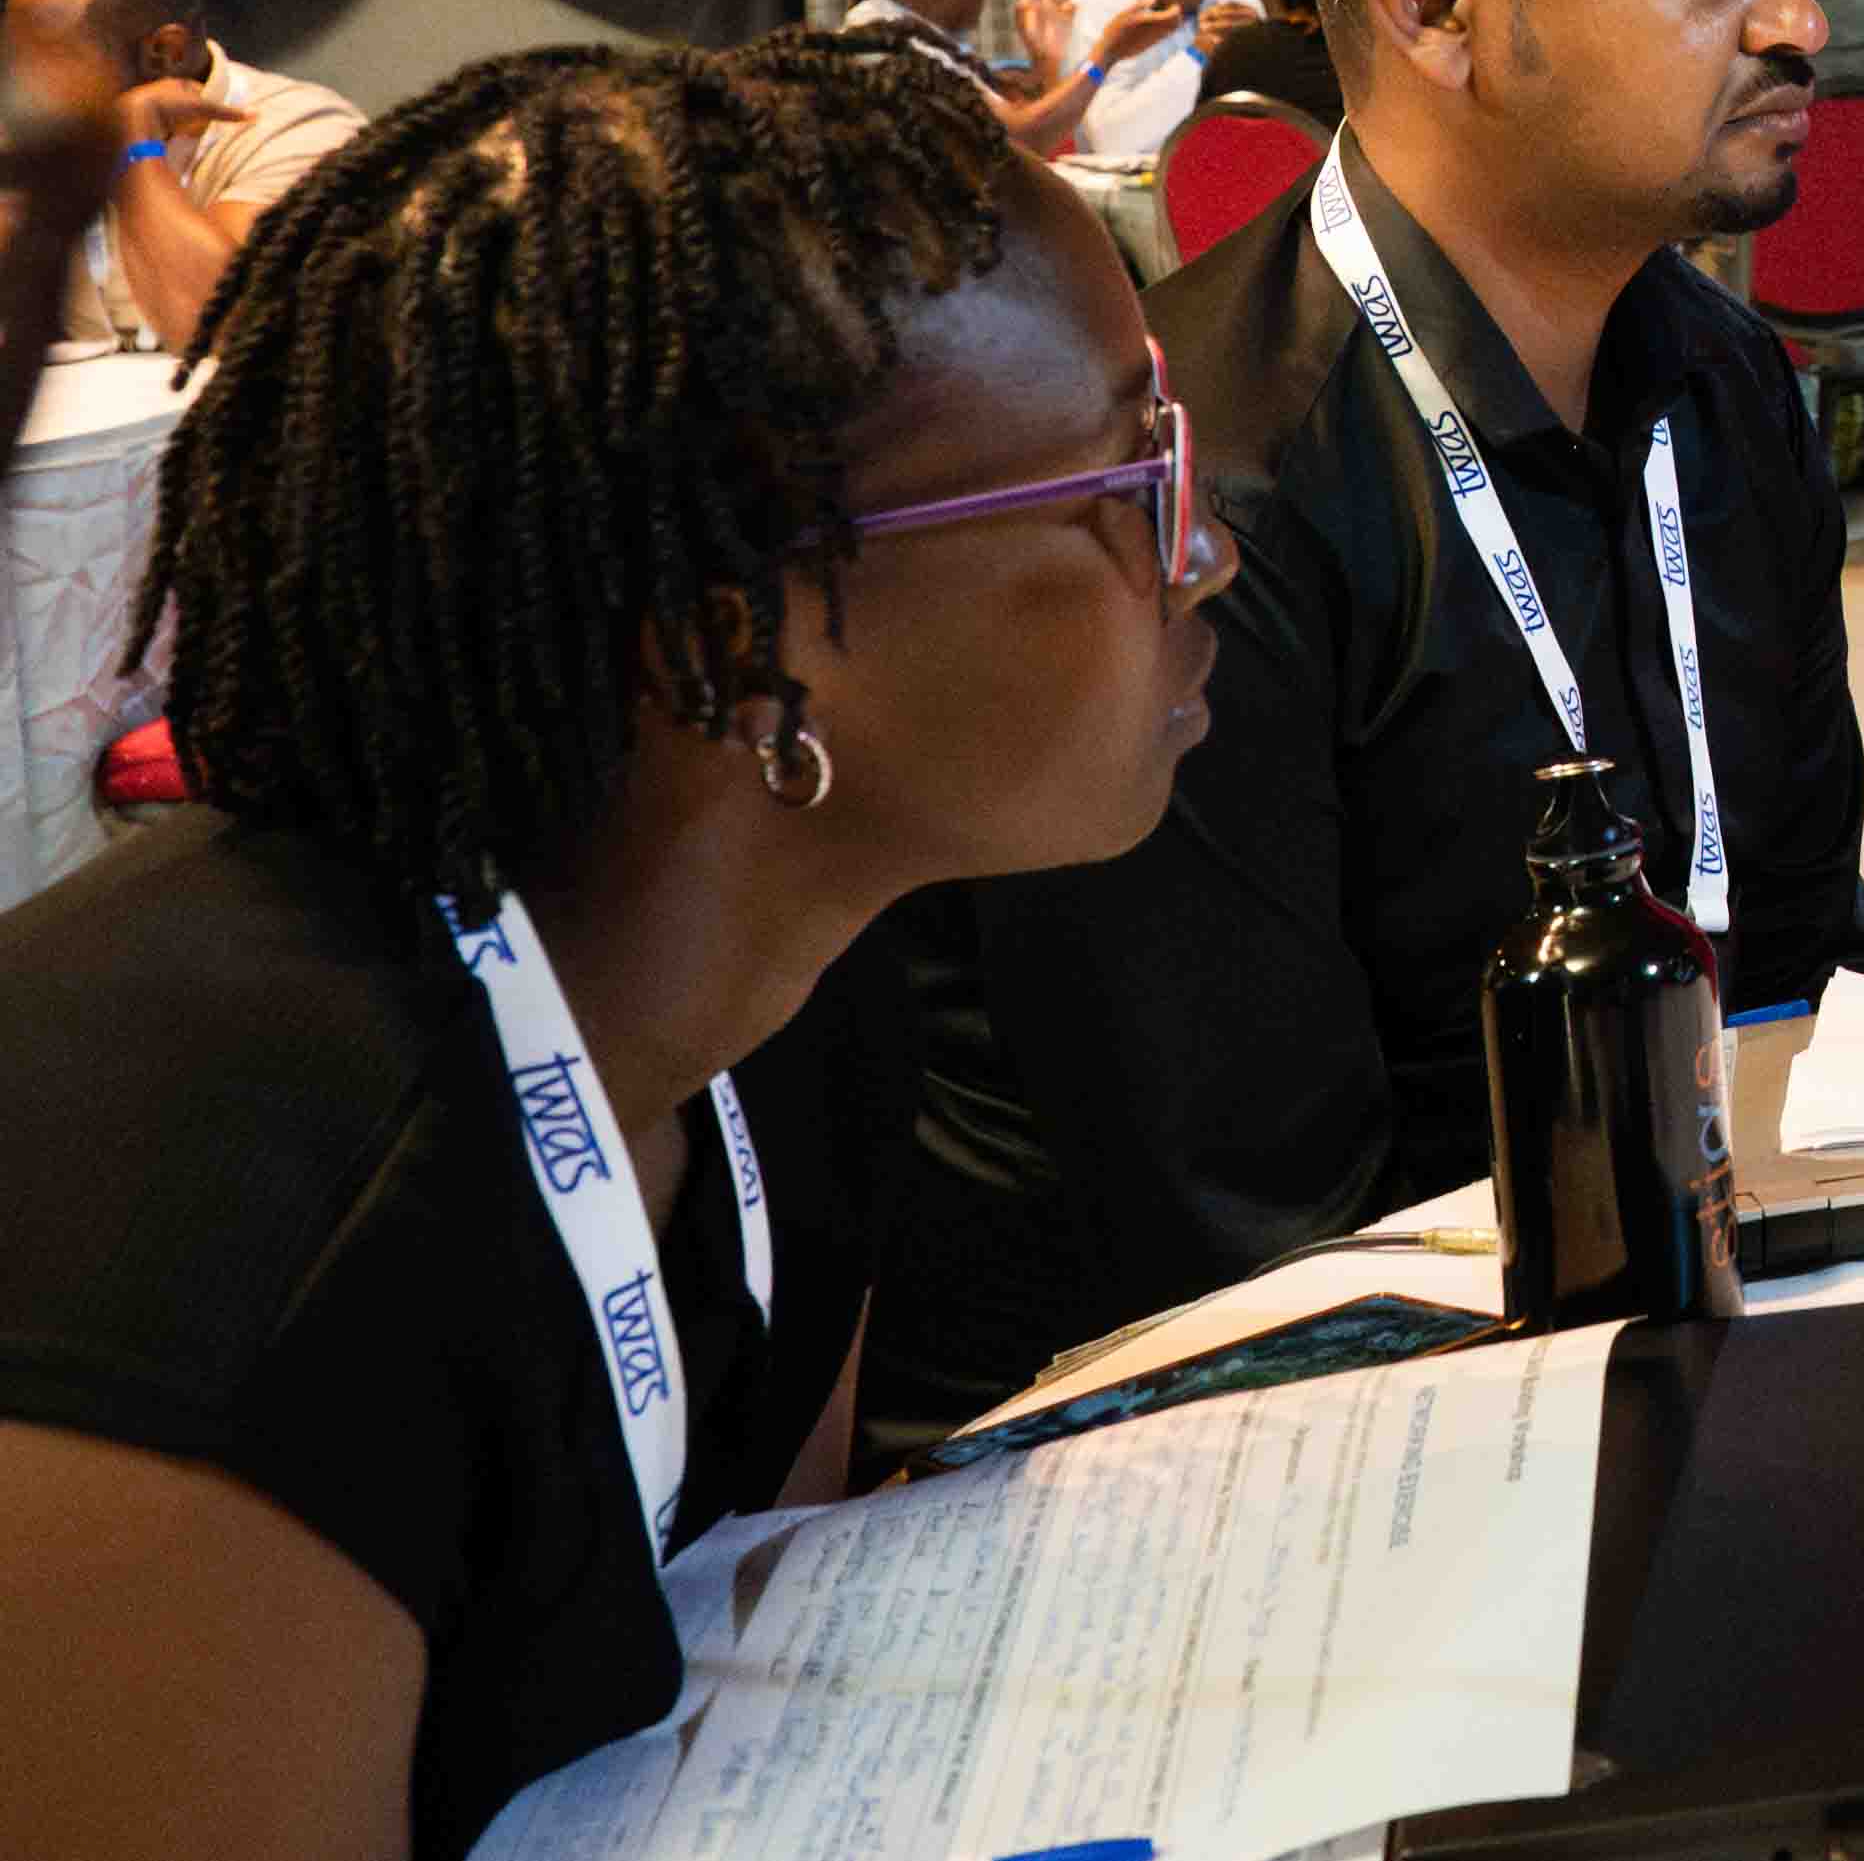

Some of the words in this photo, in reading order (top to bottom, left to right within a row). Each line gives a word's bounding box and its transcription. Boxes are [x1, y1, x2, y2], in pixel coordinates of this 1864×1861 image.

[1319, 164, 1353, 235] twas
[1352, 274, 1413, 359] twas
[1428, 411, 1487, 499] twas
[1655, 502, 1686, 588] twas
[1492, 548, 1545, 634] twas
[1685, 644, 1705, 731] twas
[1692, 788, 1723, 878] twas
[510, 1051, 612, 1195] twas
[602, 1268, 670, 1417] twas
